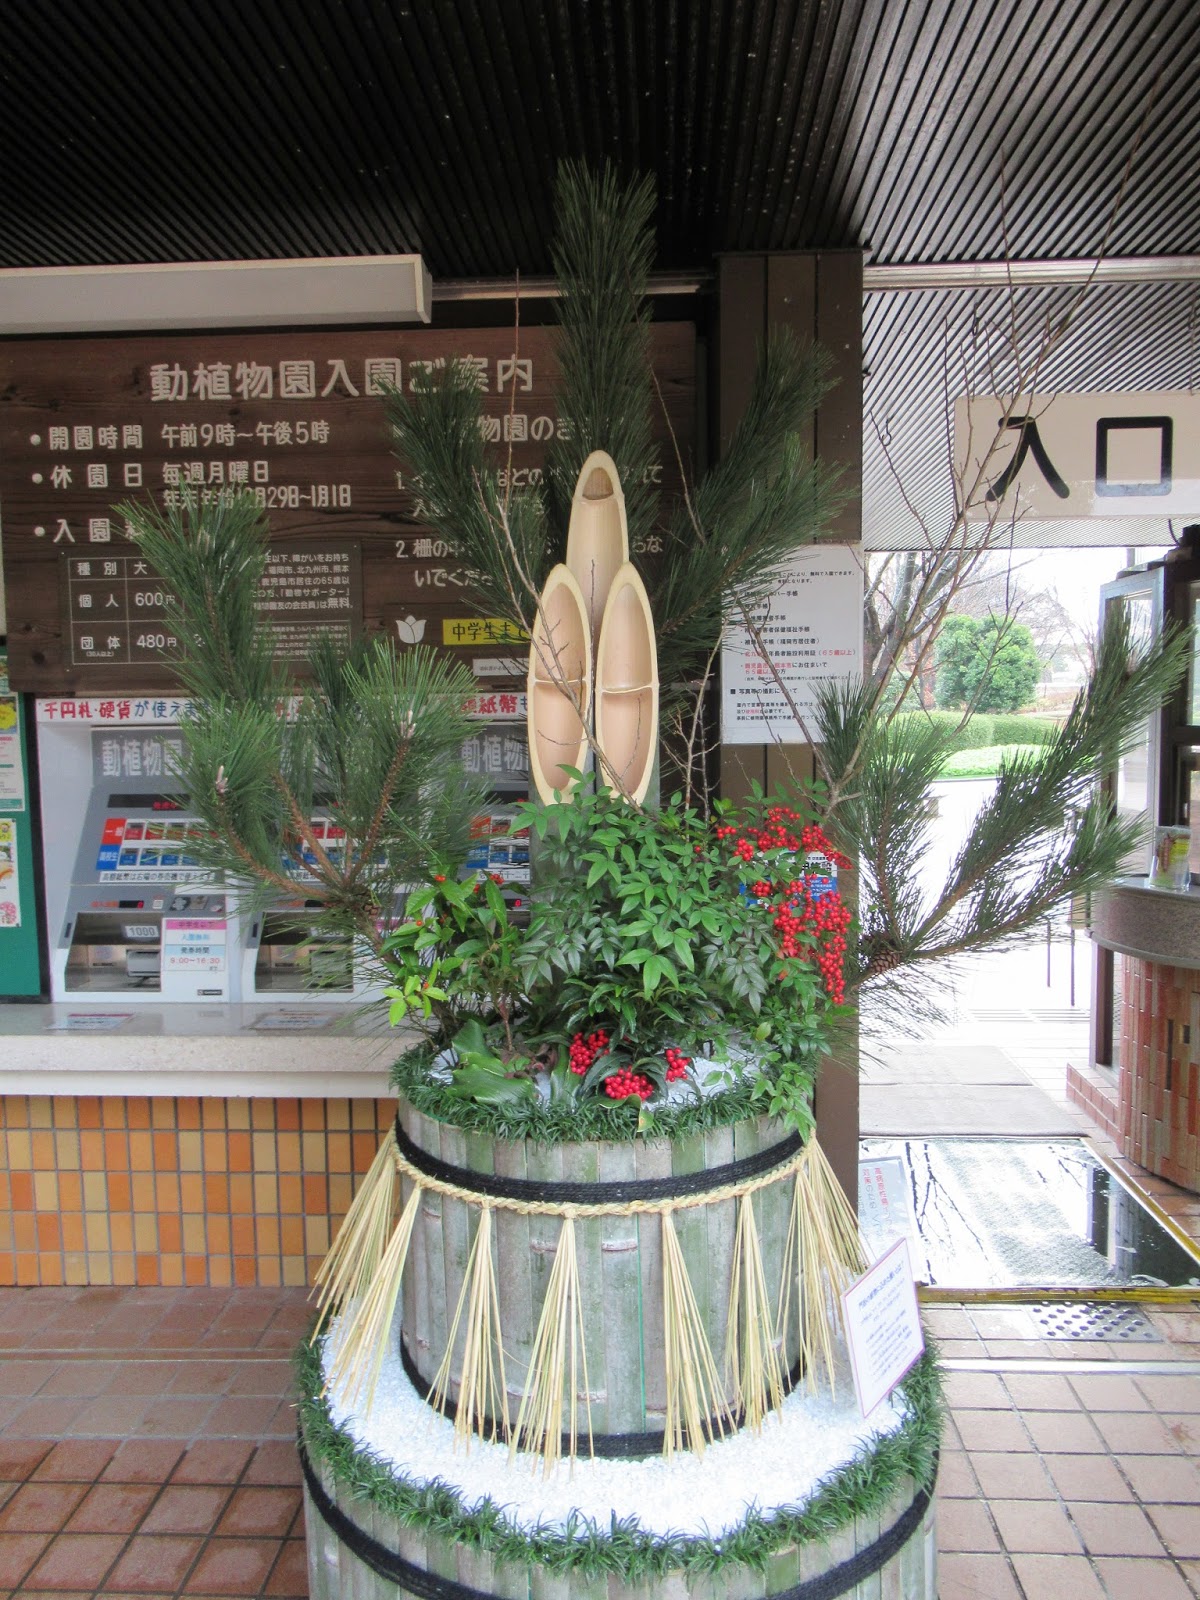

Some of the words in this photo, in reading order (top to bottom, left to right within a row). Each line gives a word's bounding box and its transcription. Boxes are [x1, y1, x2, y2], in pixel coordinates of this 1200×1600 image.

[50, 425, 143, 449] 開園時間
[985, 415, 1173, 501] 入口
[51, 463, 143, 488] 休園日
[162, 460, 269, 485] 毎週月曜日
[77, 562, 117, 576] 種別
[79, 595, 119, 608] 個人
[135, 592, 175, 606] 600円
[81, 635, 121, 649] 団体
[136, 634, 177, 648] 480円
[102, 738, 184, 777] 動植物園
